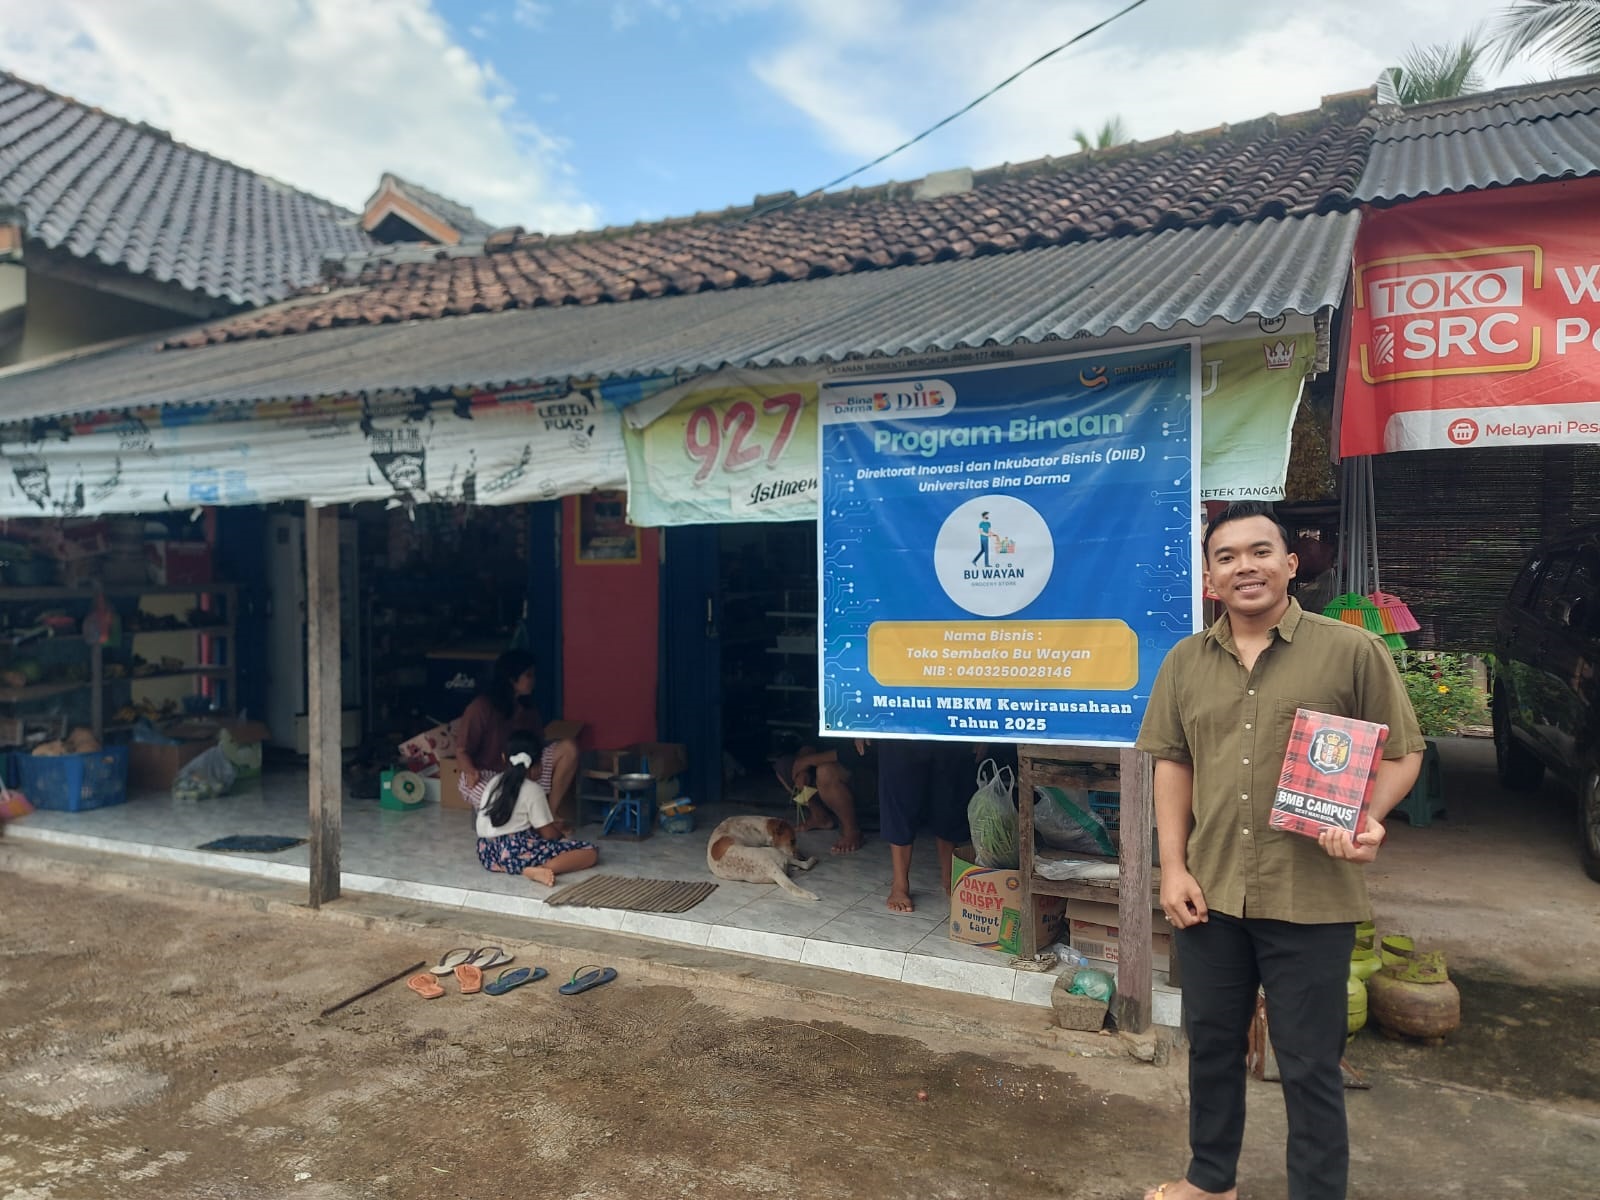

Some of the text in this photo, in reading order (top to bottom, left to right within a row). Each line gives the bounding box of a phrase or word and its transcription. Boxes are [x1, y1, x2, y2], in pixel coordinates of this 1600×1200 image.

[1378, 272, 1507, 314] TOKO
[1403, 313, 1519, 359] SRC
[875, 410, 1124, 457] Program Binaan
[1485, 421, 1562, 439] Melayani
[686, 393, 803, 487] 927
[856, 446, 1146, 480] Direktorat Inovasi dan Inkubator Bisnis (DIIB)
[918, 472, 1070, 493] Universitas Bina Darma
[1200, 488, 1235, 497] RETEK
[964, 568, 1024, 580] BU WAYAN
[944, 631, 987, 642] Nama
[990, 630, 1034, 641] Bisnis
[906, 648, 1091, 663] Toko Sembako Bu Wayan
[923, 665, 945, 677] NIB
[956, 665, 1072, 678] 0403250028146
[873, 695, 1132, 714] Melalui MBKM Kewirausahaan
[948, 715, 1046, 731] Tahun 2025
[1278, 790, 1356, 821] BMB CAMPUS
[960, 890, 1005, 911] CRISPY
[962, 908, 999, 927] Rumput
[969, 922, 991, 936] Laut
